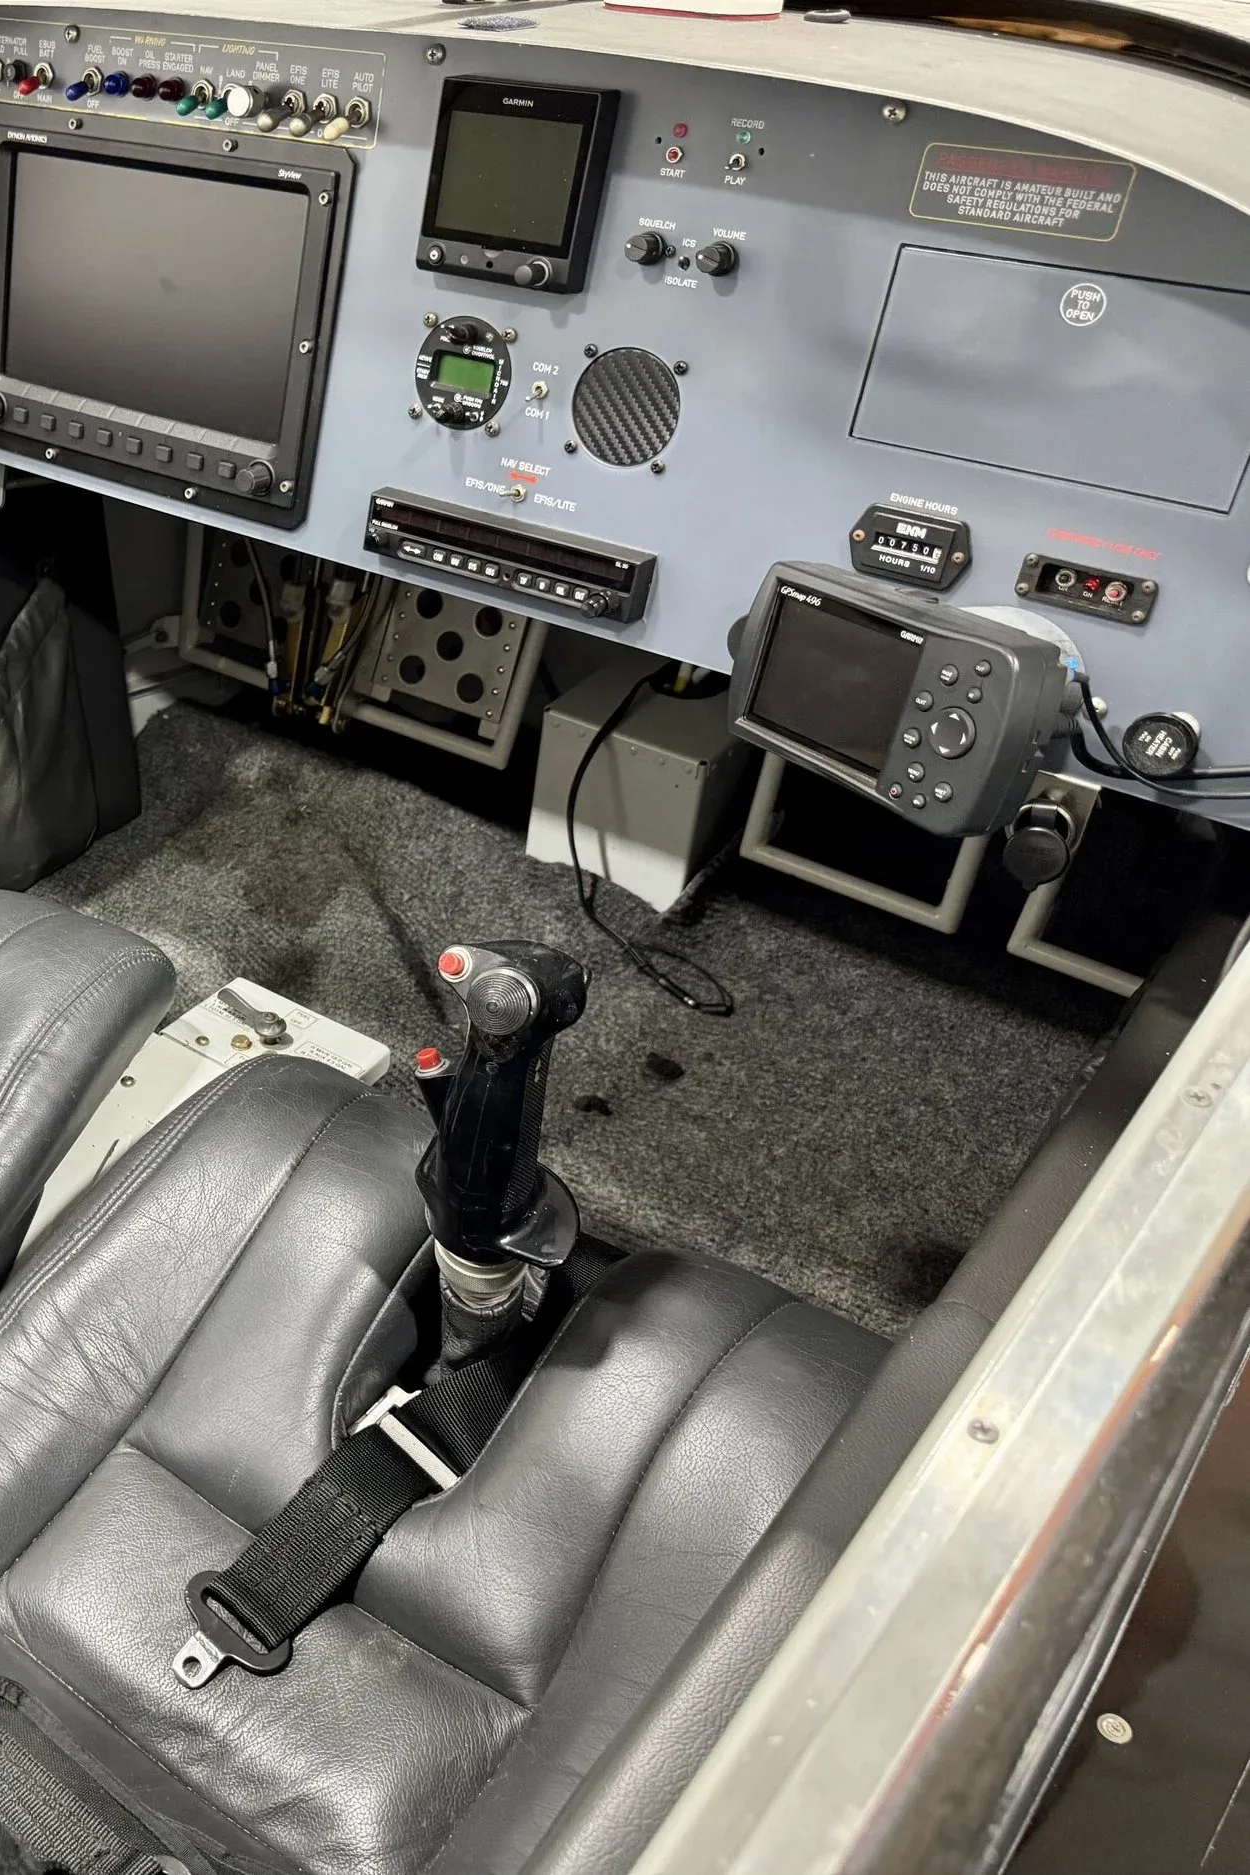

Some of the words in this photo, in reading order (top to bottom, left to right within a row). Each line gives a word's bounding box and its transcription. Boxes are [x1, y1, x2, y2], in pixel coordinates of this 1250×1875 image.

[39, 39, 56, 49] EBUS
[134, 36, 167, 46] WARNING
[13, 46, 28, 56] PULL
[39, 49, 54, 58] BATT
[87, 44, 103, 54] FUEL
[111, 46, 134, 57] BOOST
[145, 50, 155, 59] OIL
[222, 44, 256, 55] LIGHTING
[85, 54, 106, 64] BOOST
[117, 57, 127, 66] ON
[164, 52, 193, 63] STARTER
[138, 59, 161, 70] PRESS
[162, 62, 194, 73] ENGAGED
[255, 61, 279, 73] PANEL
[289, 64, 308, 75] EFIS
[199, 66, 214, 75] NAV
[226, 68, 246, 79] LAND
[322, 68, 340, 79] EFIS
[252, 71, 280, 82] DIMMER
[289, 75, 306, 85] ONE
[353, 72, 375, 83] AUTO
[321, 78, 339, 89] LITE
[352, 82, 374, 93] PILOT
[37, 94, 53, 104] MAIN
[86, 100, 100, 109] OFF
[502, 97, 534, 108] GARMIN
[224, 117, 240, 126] OFF
[730, 117, 765, 130] RECORD
[7, 131, 27, 141] DYNON
[278, 168, 302, 180] SkyView
[660, 167, 685, 179] START
[724, 174, 746, 186] PLAY
[924, 171, 947, 183] THIS
[949, 174, 999, 188] AIRCRAFT
[1000, 180, 1012, 191] IS
[1013, 182, 1063, 196] AMATEUR
[1064, 187, 1096, 200] BUILT
[1097, 192, 1122, 204] AND
[922, 181, 950, 193] DOES
[952, 185, 973, 195] NOT
[974, 187, 1013, 200] COMPLY
[1015, 192, 1041, 204] WITH
[1043, 195, 1064, 207] THE
[1066, 198, 1114, 214] FEDERAL
[946, 195, 985, 207] SAFETY
[985, 199, 1056, 216] REGULATIONS
[1058, 208, 1080, 219] FOR
[958, 206, 1011, 220] STANDARD
[1013, 213, 1065, 227] AIRCRAFT
[638, 217, 677, 231] SQUELCH
[712, 227, 747, 241] VOLUME
[682, 238, 697, 248] ICS
[664, 276, 698, 289] ISOLATE
[1070, 289, 1101, 302] PUSH
[1077, 300, 1090, 310] TO
[1065, 308, 1095, 321] OPEN
[532, 362, 550, 375] COM
[552, 366, 559, 375] 2
[525, 407, 545, 419] COM
[545, 411, 550, 421] 1
[501, 457, 517, 469] NAV
[518, 461, 551, 477] SELECT
[465, 477, 506, 493] EFIS/ONE
[533, 493, 577, 512] EFIS/LITE
[890, 493, 924, 508] ENGINE
[925, 500, 959, 515] HOURS
[896, 522, 927, 539] ENM
[879, 554, 911, 568] HOURS
[920, 564, 936, 574] 1/10
[780, 585, 806, 602] GPSmap
[805, 595, 823, 607] 496
[1083, 591, 1094, 599] ON
[1145, 730, 1167, 756] HEATER
[1155, 737, 1173, 758] CABIN
